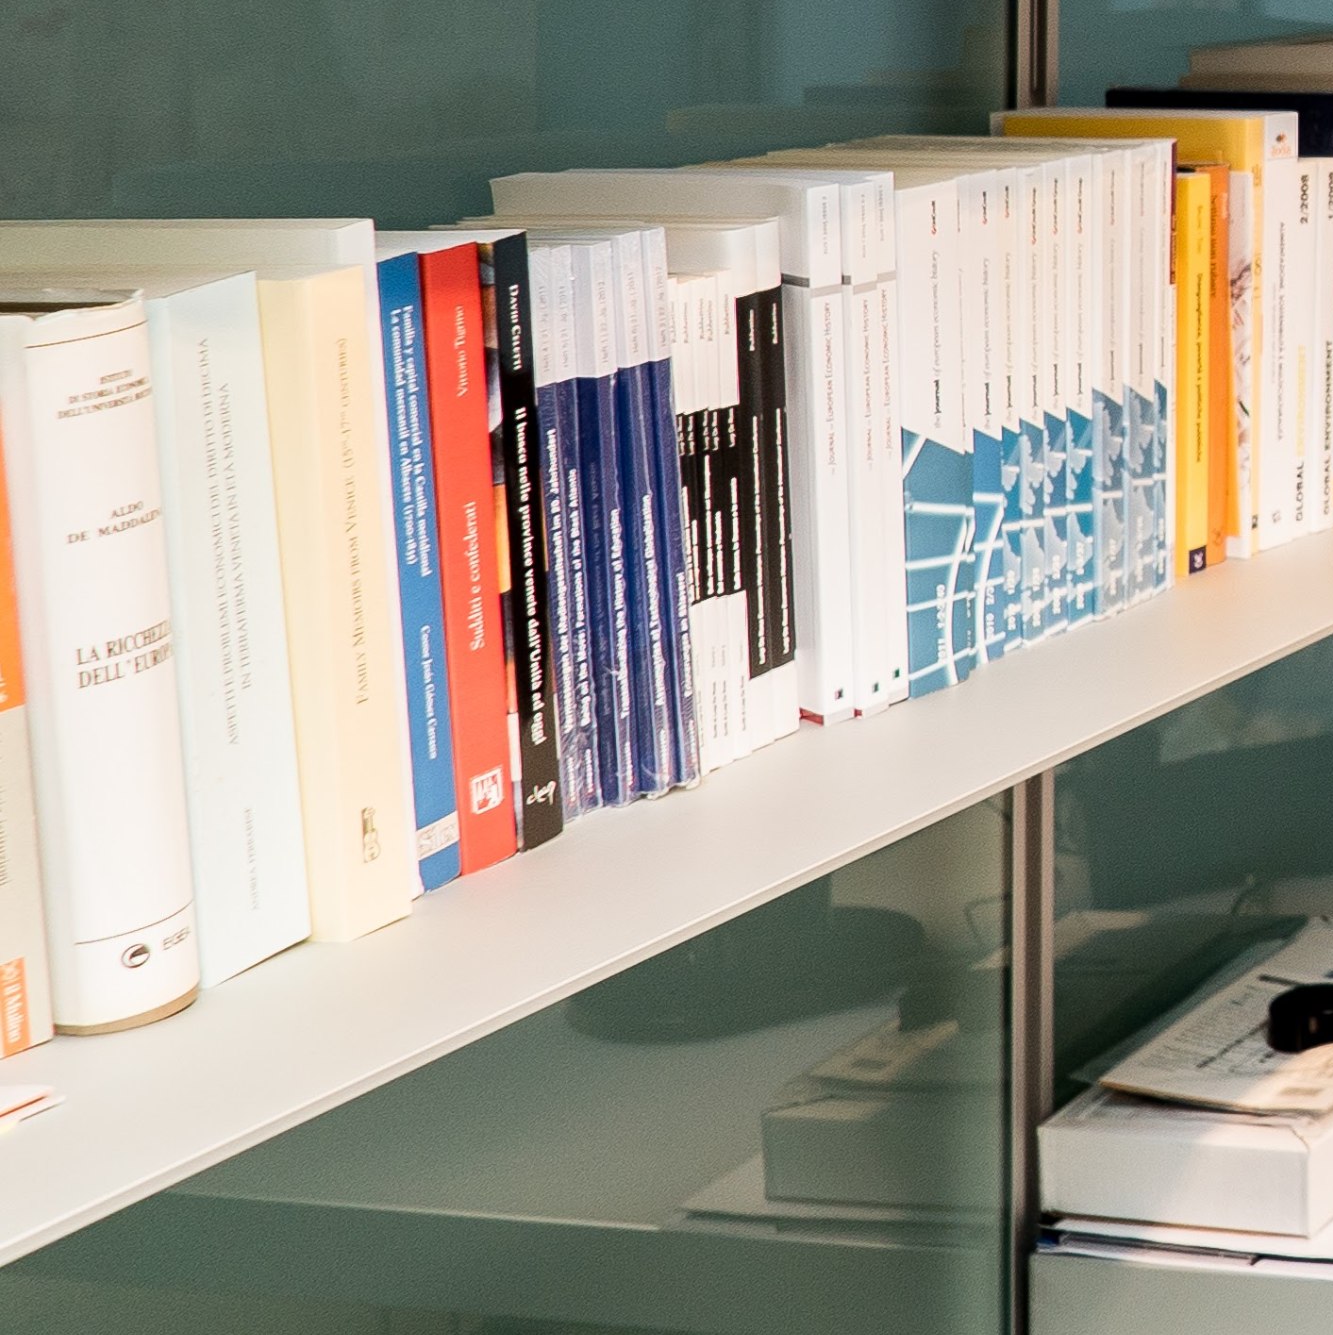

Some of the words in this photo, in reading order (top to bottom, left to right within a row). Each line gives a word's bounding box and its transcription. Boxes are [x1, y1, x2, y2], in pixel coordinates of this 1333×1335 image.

[930, 250, 939, 279] history
[391, 309, 403, 323] La
[402, 306, 417, 345] Familia
[454, 306, 466, 348] Tigrino
[198, 338, 212, 397] DECIMA
[392, 325, 407, 387] comunidad
[405, 357, 420, 392] capital
[457, 351, 469, 396] Vittorio
[202, 400, 214, 415] DI
[395, 389, 410, 438] mercantil
[514, 406, 526, 420] Il
[1324, 341, 1333, 451] ENVIRONMENT
[218, 383, 234, 458] MODERNA
[408, 395, 423, 445] comercial
[204, 419, 218, 477] DIRITTO
[398, 442, 411, 455] en
[411, 448, 424, 460] en
[515, 422, 529, 463] bosco
[547, 429, 559, 494] Jahrhundert
[399, 458, 414, 503] Albacete
[412, 463, 425, 473] la
[517, 466, 531, 502] nelle
[1323, 459, 1331, 515] GLOBAL
[208, 483, 221, 509] DEL
[413, 476, 428, 516] Castilla
[568, 469, 578, 507] Atlantic
[1296, 462, 1304, 521] GLOBAL
[112, 501, 143, 519] ALDO
[552, 515, 561, 530] im
[569, 511, 580, 538] Black
[67, 531, 89, 544] DE
[228, 513, 243, 570] VENETA
[416, 519, 432, 576] meridional
[463, 501, 481, 582] confederati
[520, 504, 535, 567] province
[571, 540, 580, 556] the
[611, 509, 621, 559] Education
[211, 515, 227, 596] ECONOMICI
[572, 559, 581, 570] of
[612, 560, 621, 572] of
[470, 585, 480, 593] e
[523, 569, 539, 616] venete
[574, 572, 585, 628] Formations
[613, 574, 624, 611] History
[217, 600, 233, 674] PROBLEMI
[233, 574, 250, 668] TERRAFERMA
[467, 597, 485, 651] Sudditi
[615, 611, 624, 628] the
[76, 645, 100, 665] LA
[577, 663, 588, 680] the
[241, 673, 252, 689] IN
[223, 689, 238, 745] ASPETTI
[530, 692, 545, 710] ad
[531, 712, 547, 745] oggi
